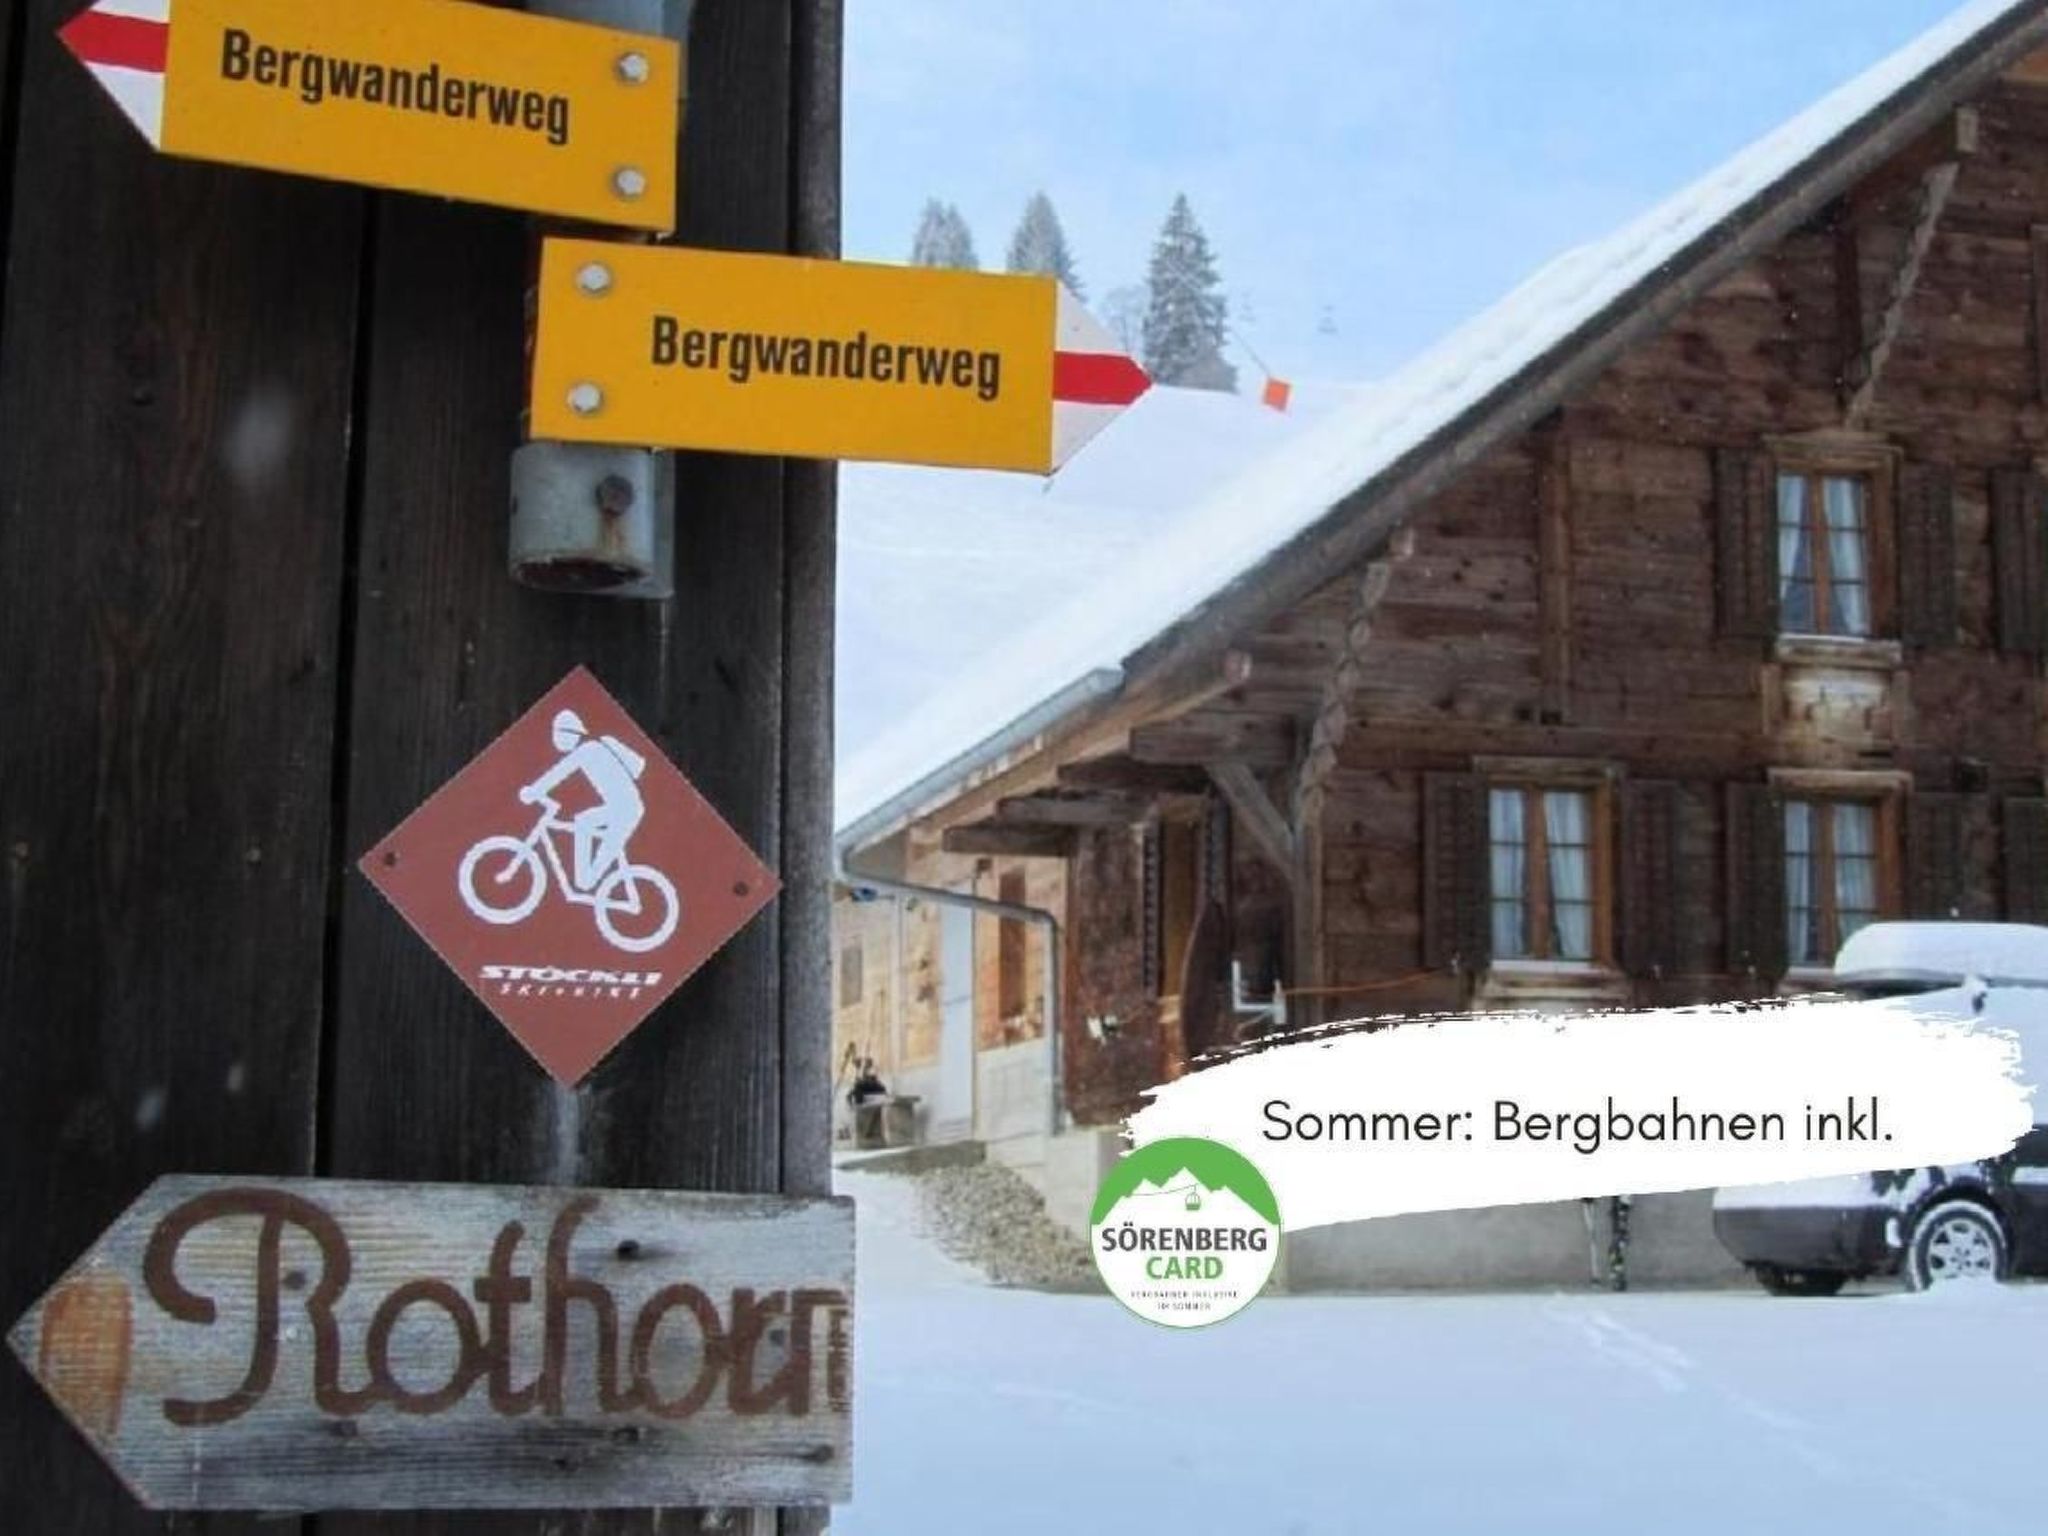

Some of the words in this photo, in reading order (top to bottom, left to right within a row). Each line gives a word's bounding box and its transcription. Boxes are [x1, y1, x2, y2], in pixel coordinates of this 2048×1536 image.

[221, 28, 570, 145] Bergwanderweg
[651, 314, 1001, 401] Bergwanderweg
[143, 1188, 849, 1427] Rothorn
